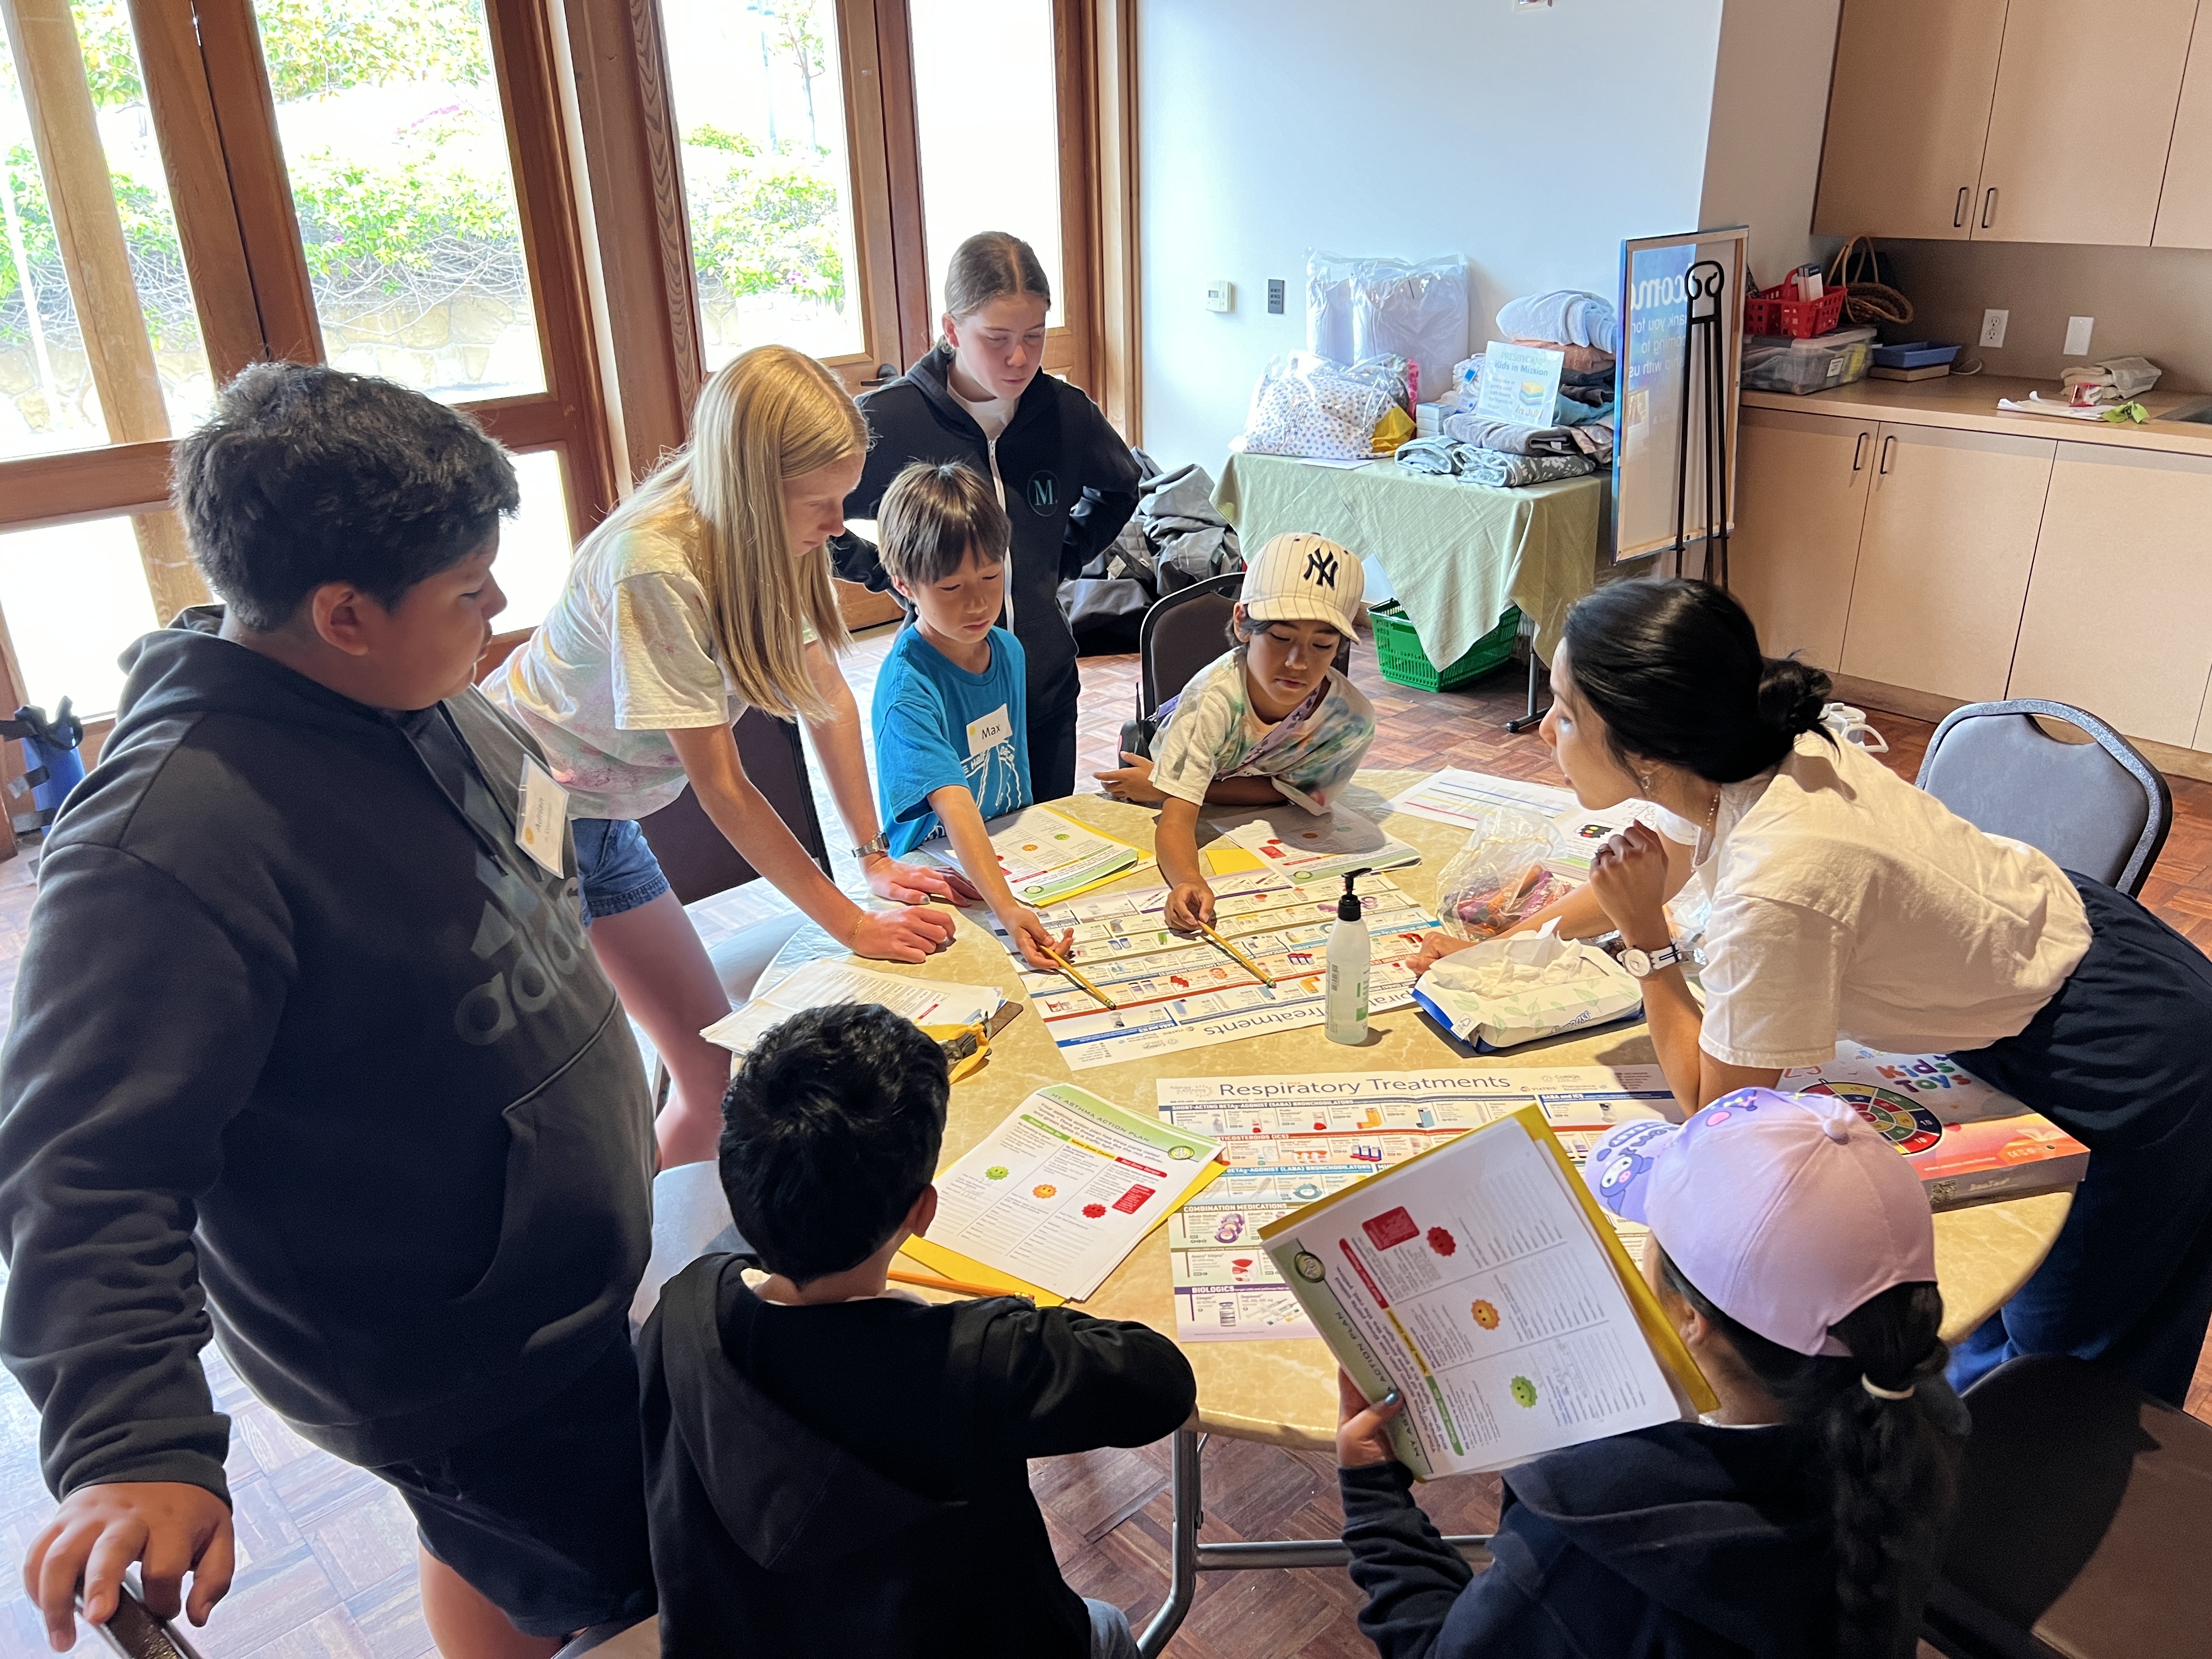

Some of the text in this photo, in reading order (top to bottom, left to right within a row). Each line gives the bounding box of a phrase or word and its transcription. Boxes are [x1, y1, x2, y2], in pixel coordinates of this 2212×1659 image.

[1495, 360, 1548, 376] Kids in Mission
[1502, 352, 1545, 365] PRESBYCAMP
[1515, 405, 1524, 415] In
[1303, 548, 1339, 591] NY
[981, 724, 1001, 740] Max
[1876, 1058, 1955, 1079] Kids
[1220, 1076, 1511, 1097] Respiratory Treatments
[1893, 1074, 1971, 1093] Toys
[1041, 1103, 1053, 1111] Your
[1053, 1109, 1073, 1122] asthma
[1073, 1120, 1090, 1131] action
[1090, 1128, 1102, 1137] plan
[1064, 1098, 1094, 1118] ASTHMA
[1097, 1116, 1127, 1132] ACTION
[1128, 1130, 1150, 1142] PLAN
[1336, 1312, 1356, 1339] PLAN
[1357, 1344, 1386, 1382] ACTION
